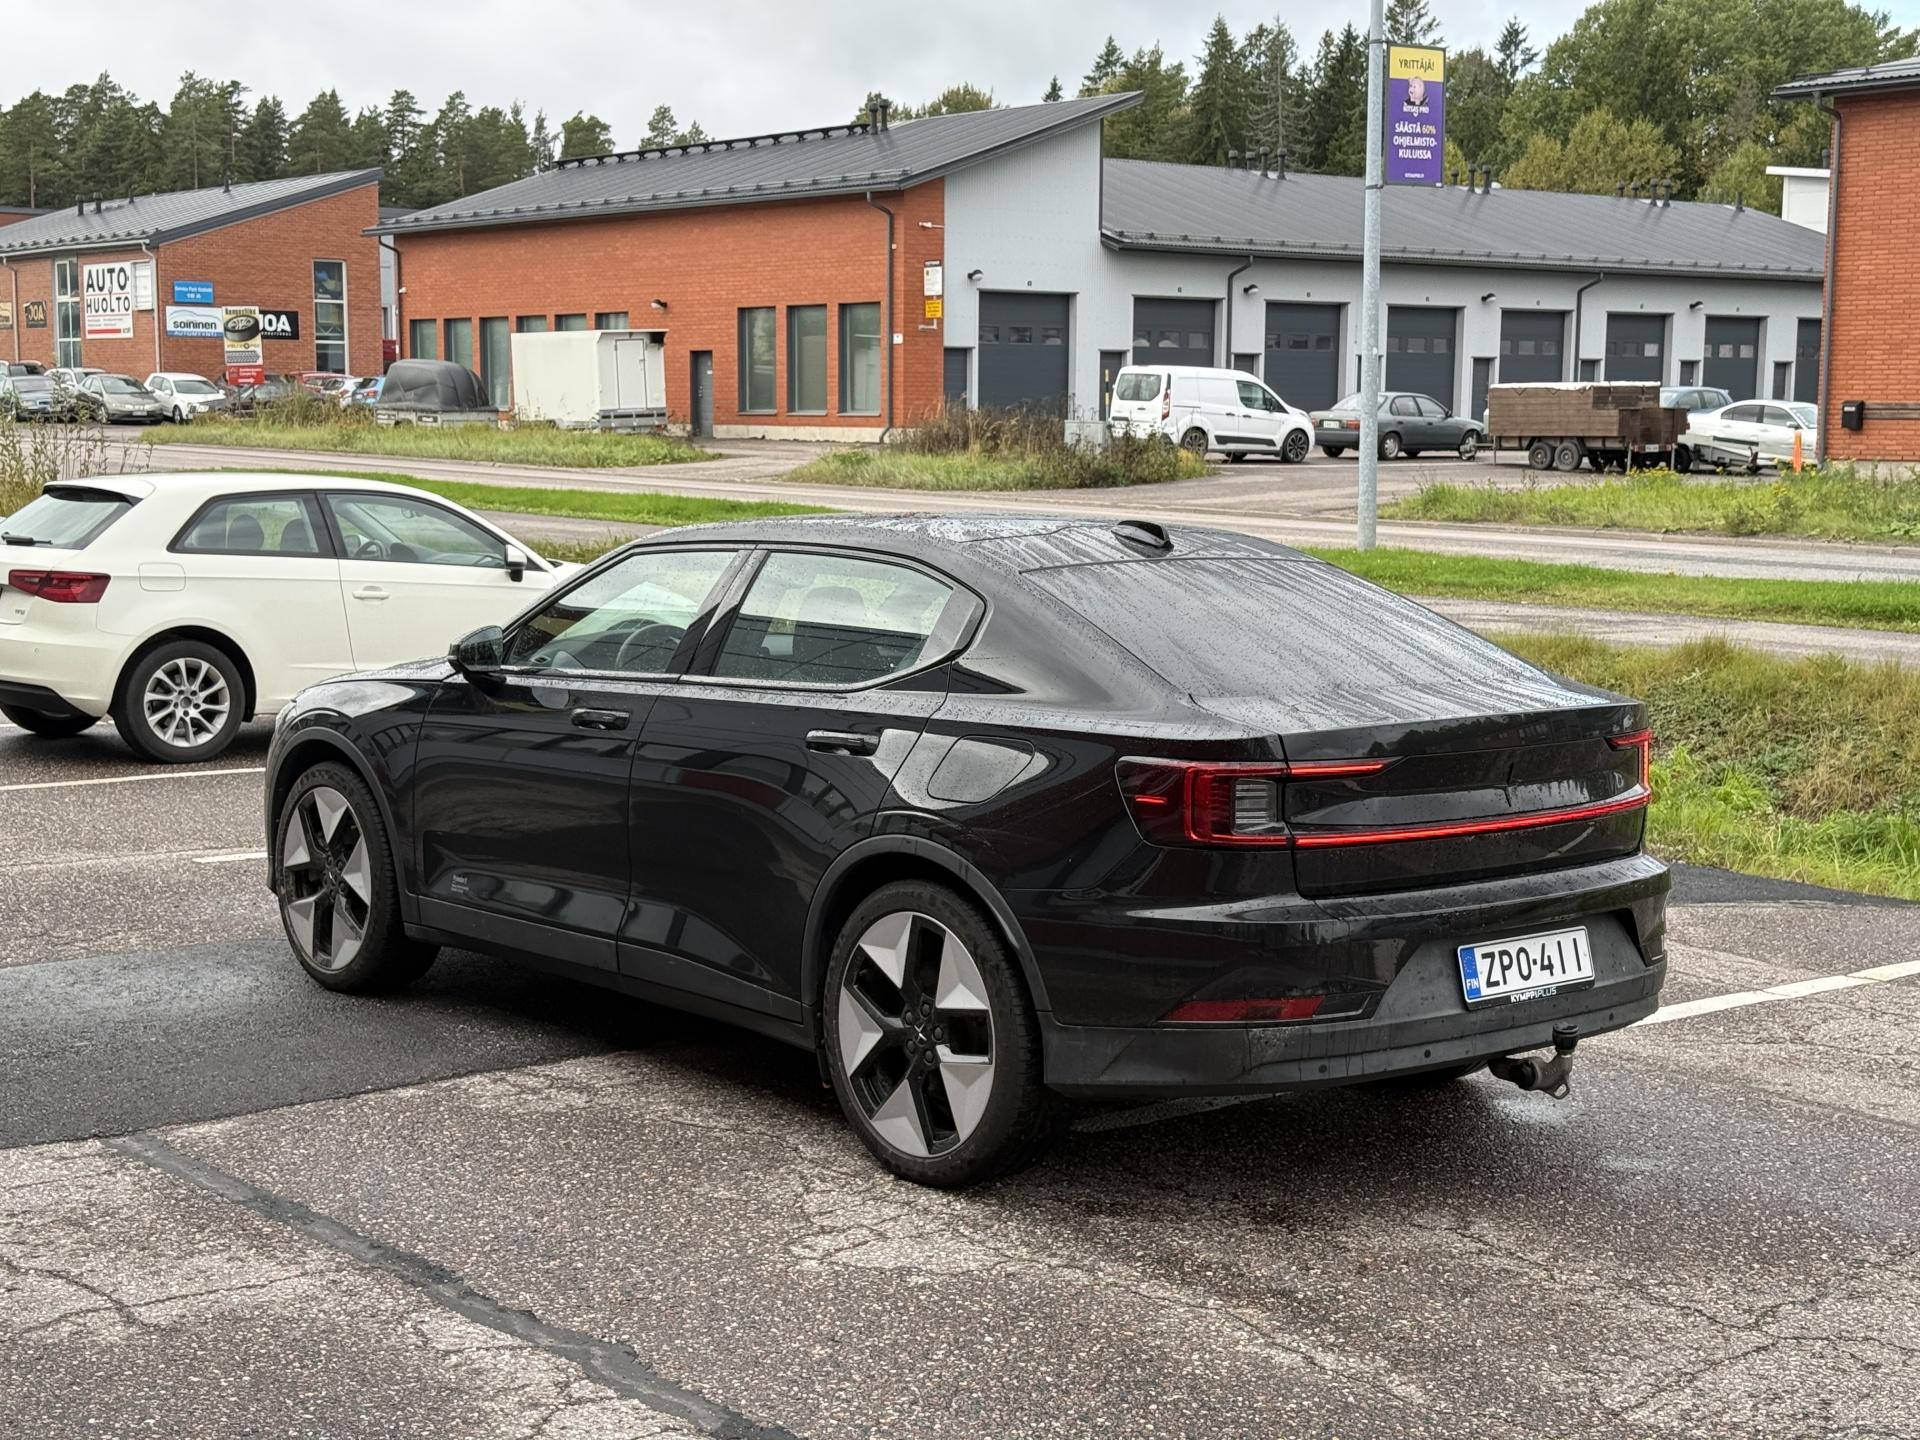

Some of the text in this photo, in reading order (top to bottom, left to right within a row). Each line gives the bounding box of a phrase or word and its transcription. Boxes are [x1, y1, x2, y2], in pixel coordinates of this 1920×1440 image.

[1399, 57, 1435, 73] YRITTÄJÄ!
[1395, 121, 1436, 135] SÄÄSTÄ 60%
[1393, 136, 1437, 147] OHJELMISTO-
[1399, 148, 1432, 160] KULUISSA
[86, 296, 130, 314] HUOLTO
[173, 320, 217, 330] soininen
[1481, 937, 1582, 988] ZPO-411
[1466, 978, 1480, 990] FIN
